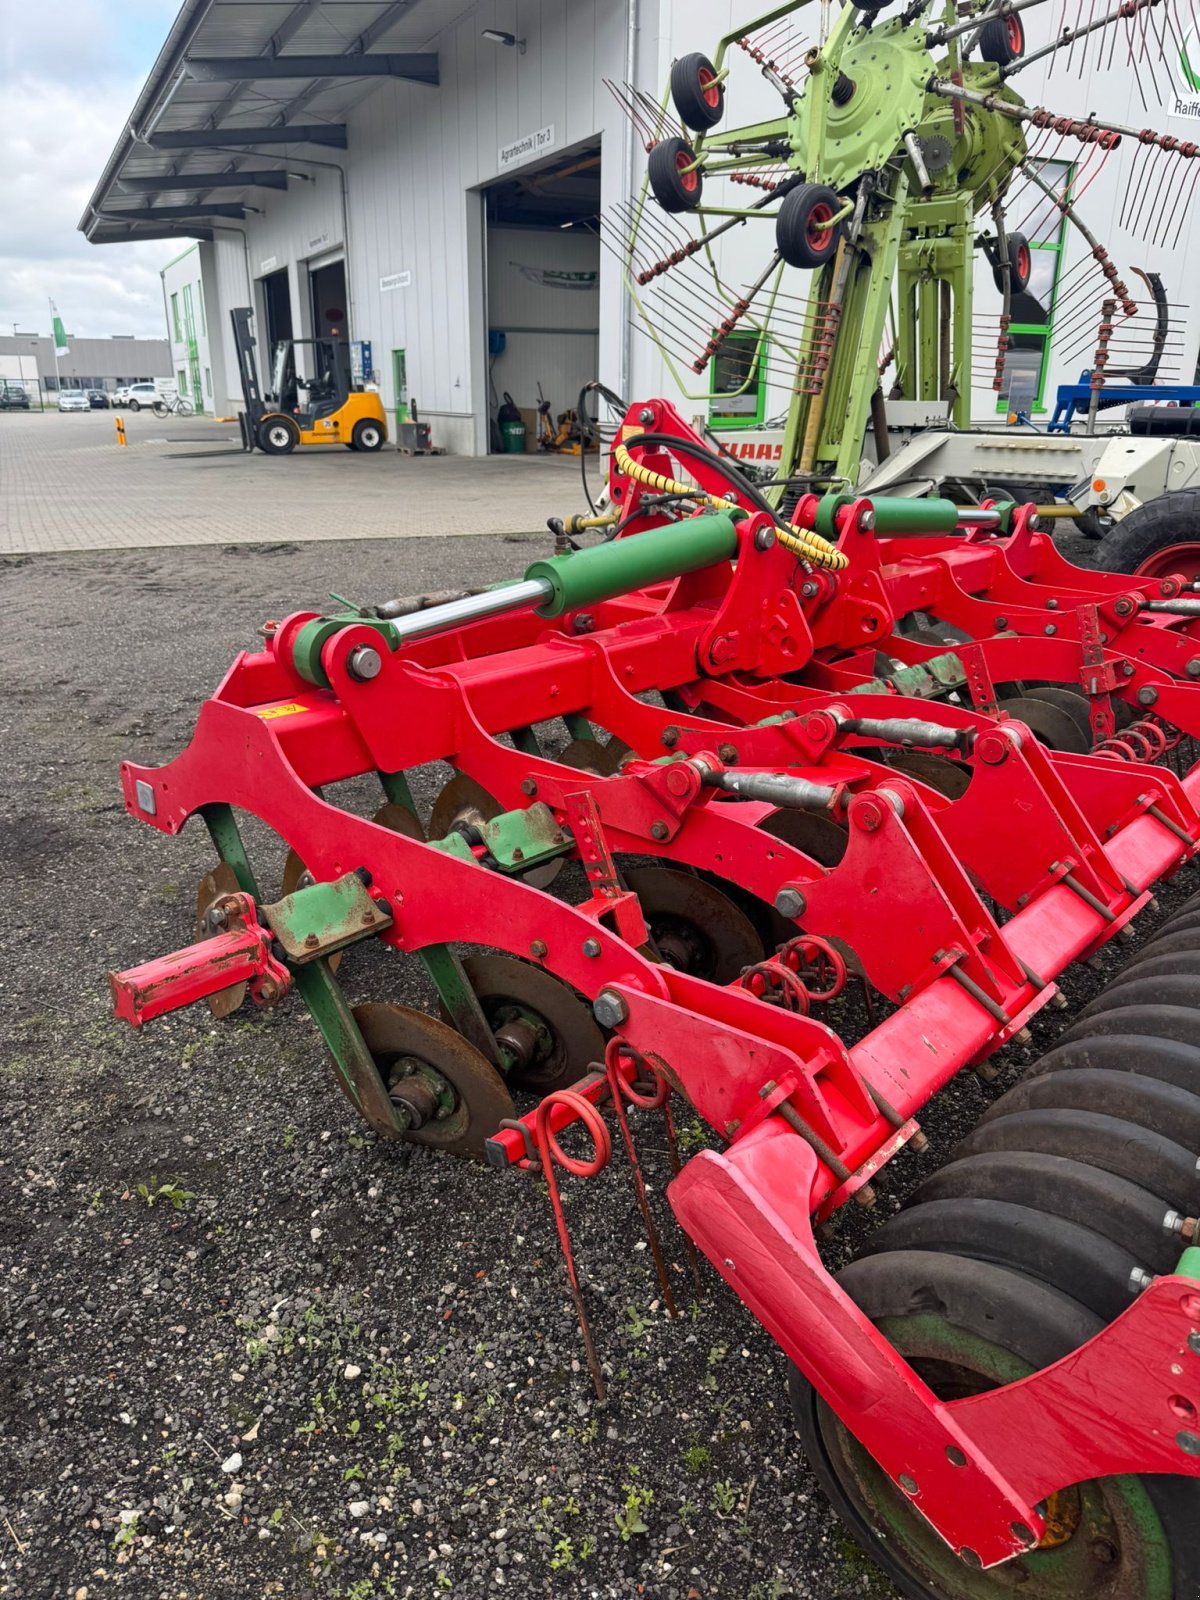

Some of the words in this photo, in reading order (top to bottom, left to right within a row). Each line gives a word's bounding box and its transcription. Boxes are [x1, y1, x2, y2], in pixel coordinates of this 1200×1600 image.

[501, 137, 533, 163] Agrartechnik
[537, 132, 546, 146] Tor
[546, 128, 551, 142] 3
